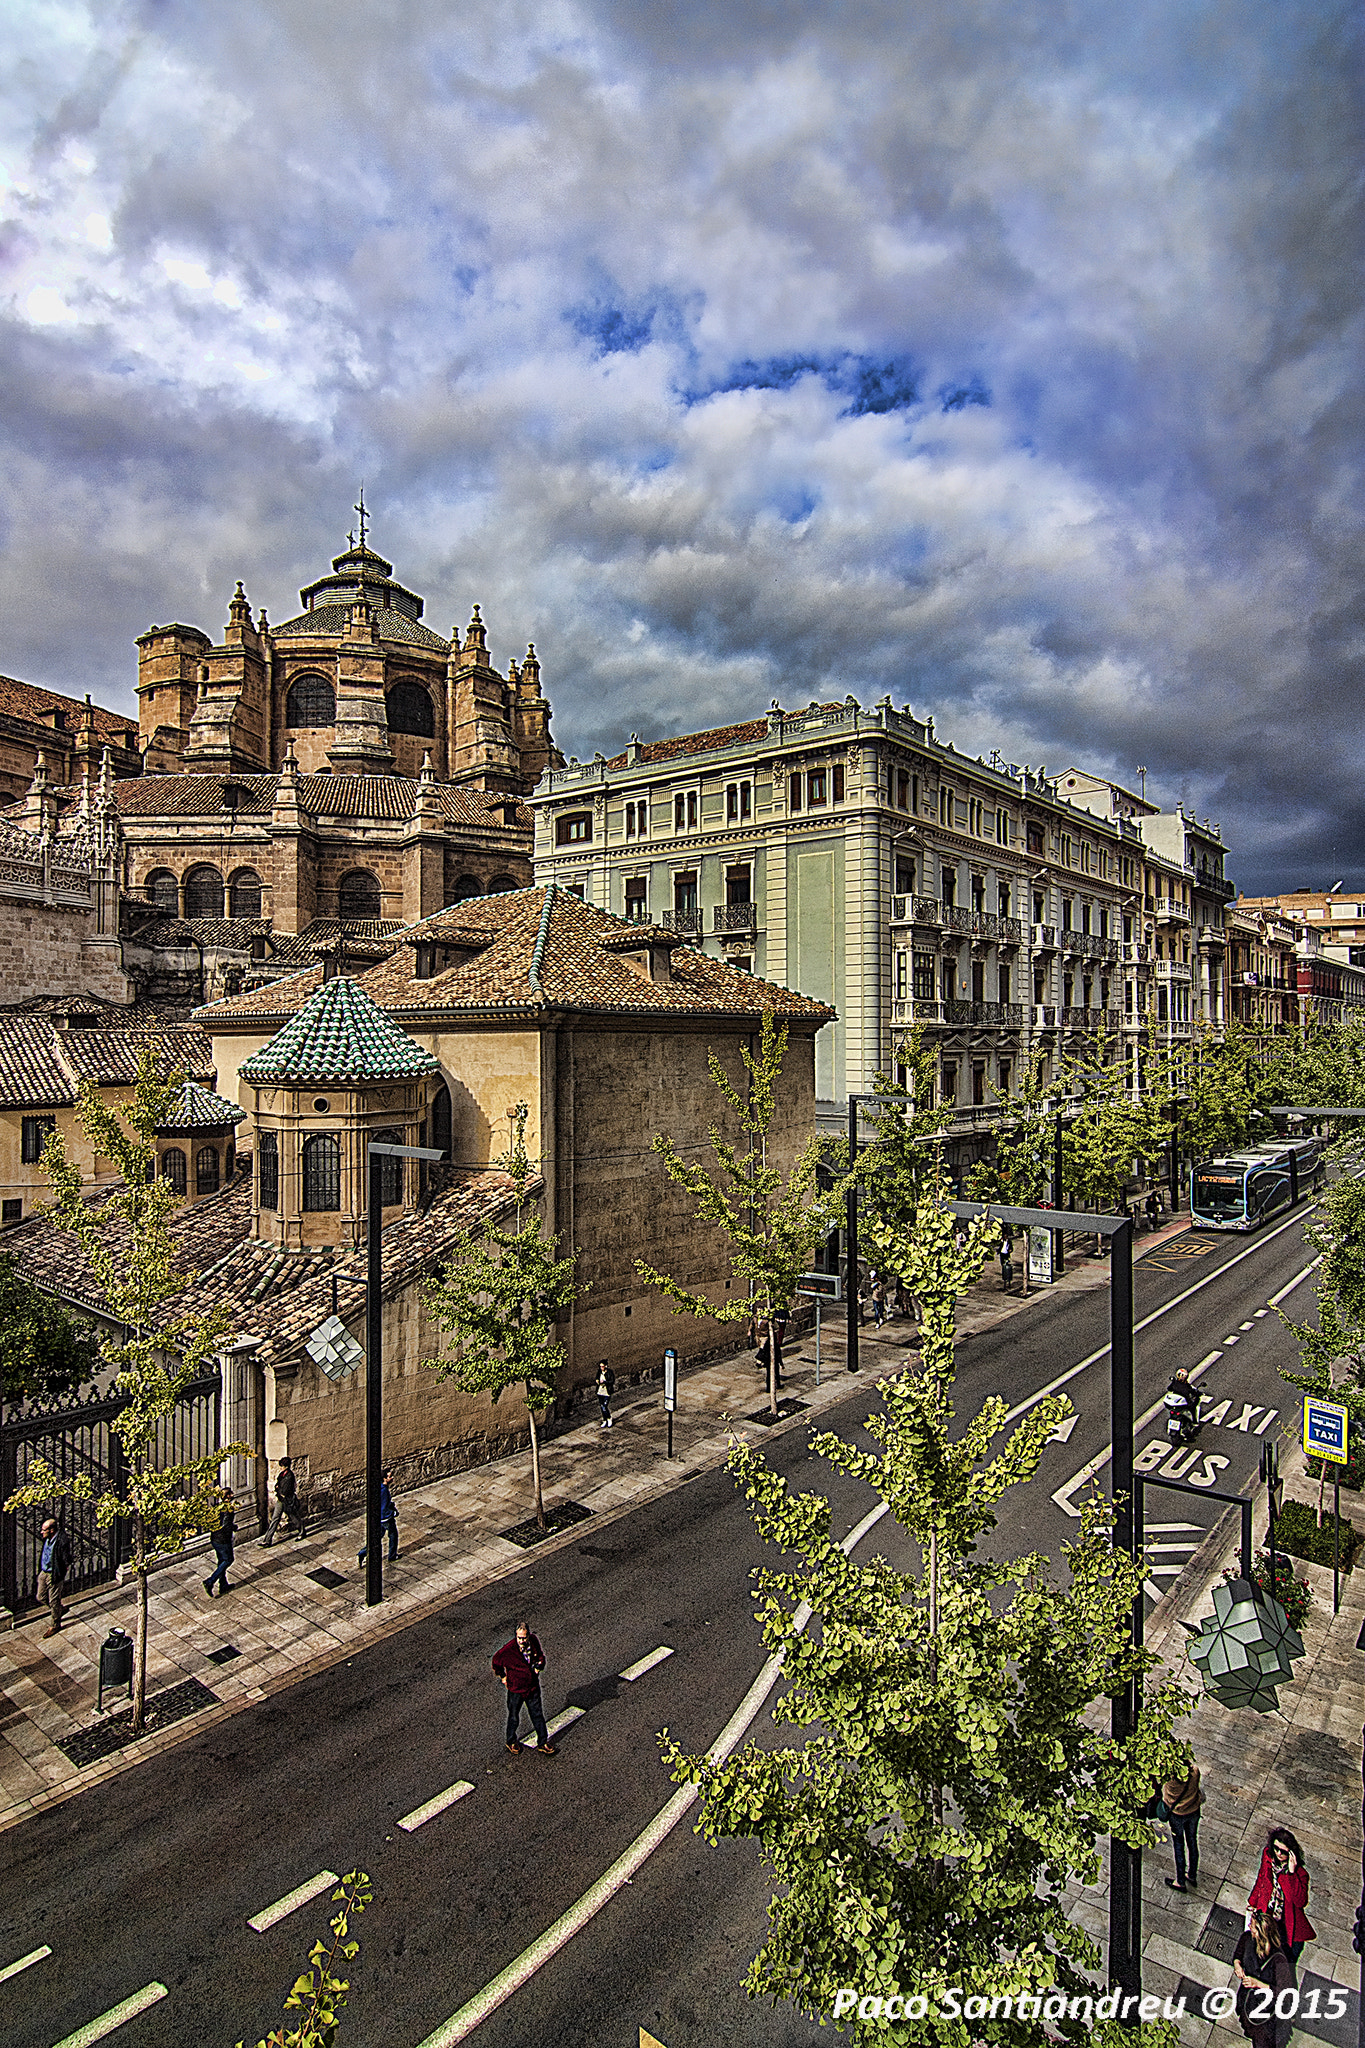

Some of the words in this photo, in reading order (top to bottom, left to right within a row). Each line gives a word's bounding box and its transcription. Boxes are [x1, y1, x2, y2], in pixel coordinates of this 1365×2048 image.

[1163, 1243, 1217, 1256] BUS
[1313, 1428, 1338, 1442] TAXI
[1132, 1439, 1231, 1487] BUS
